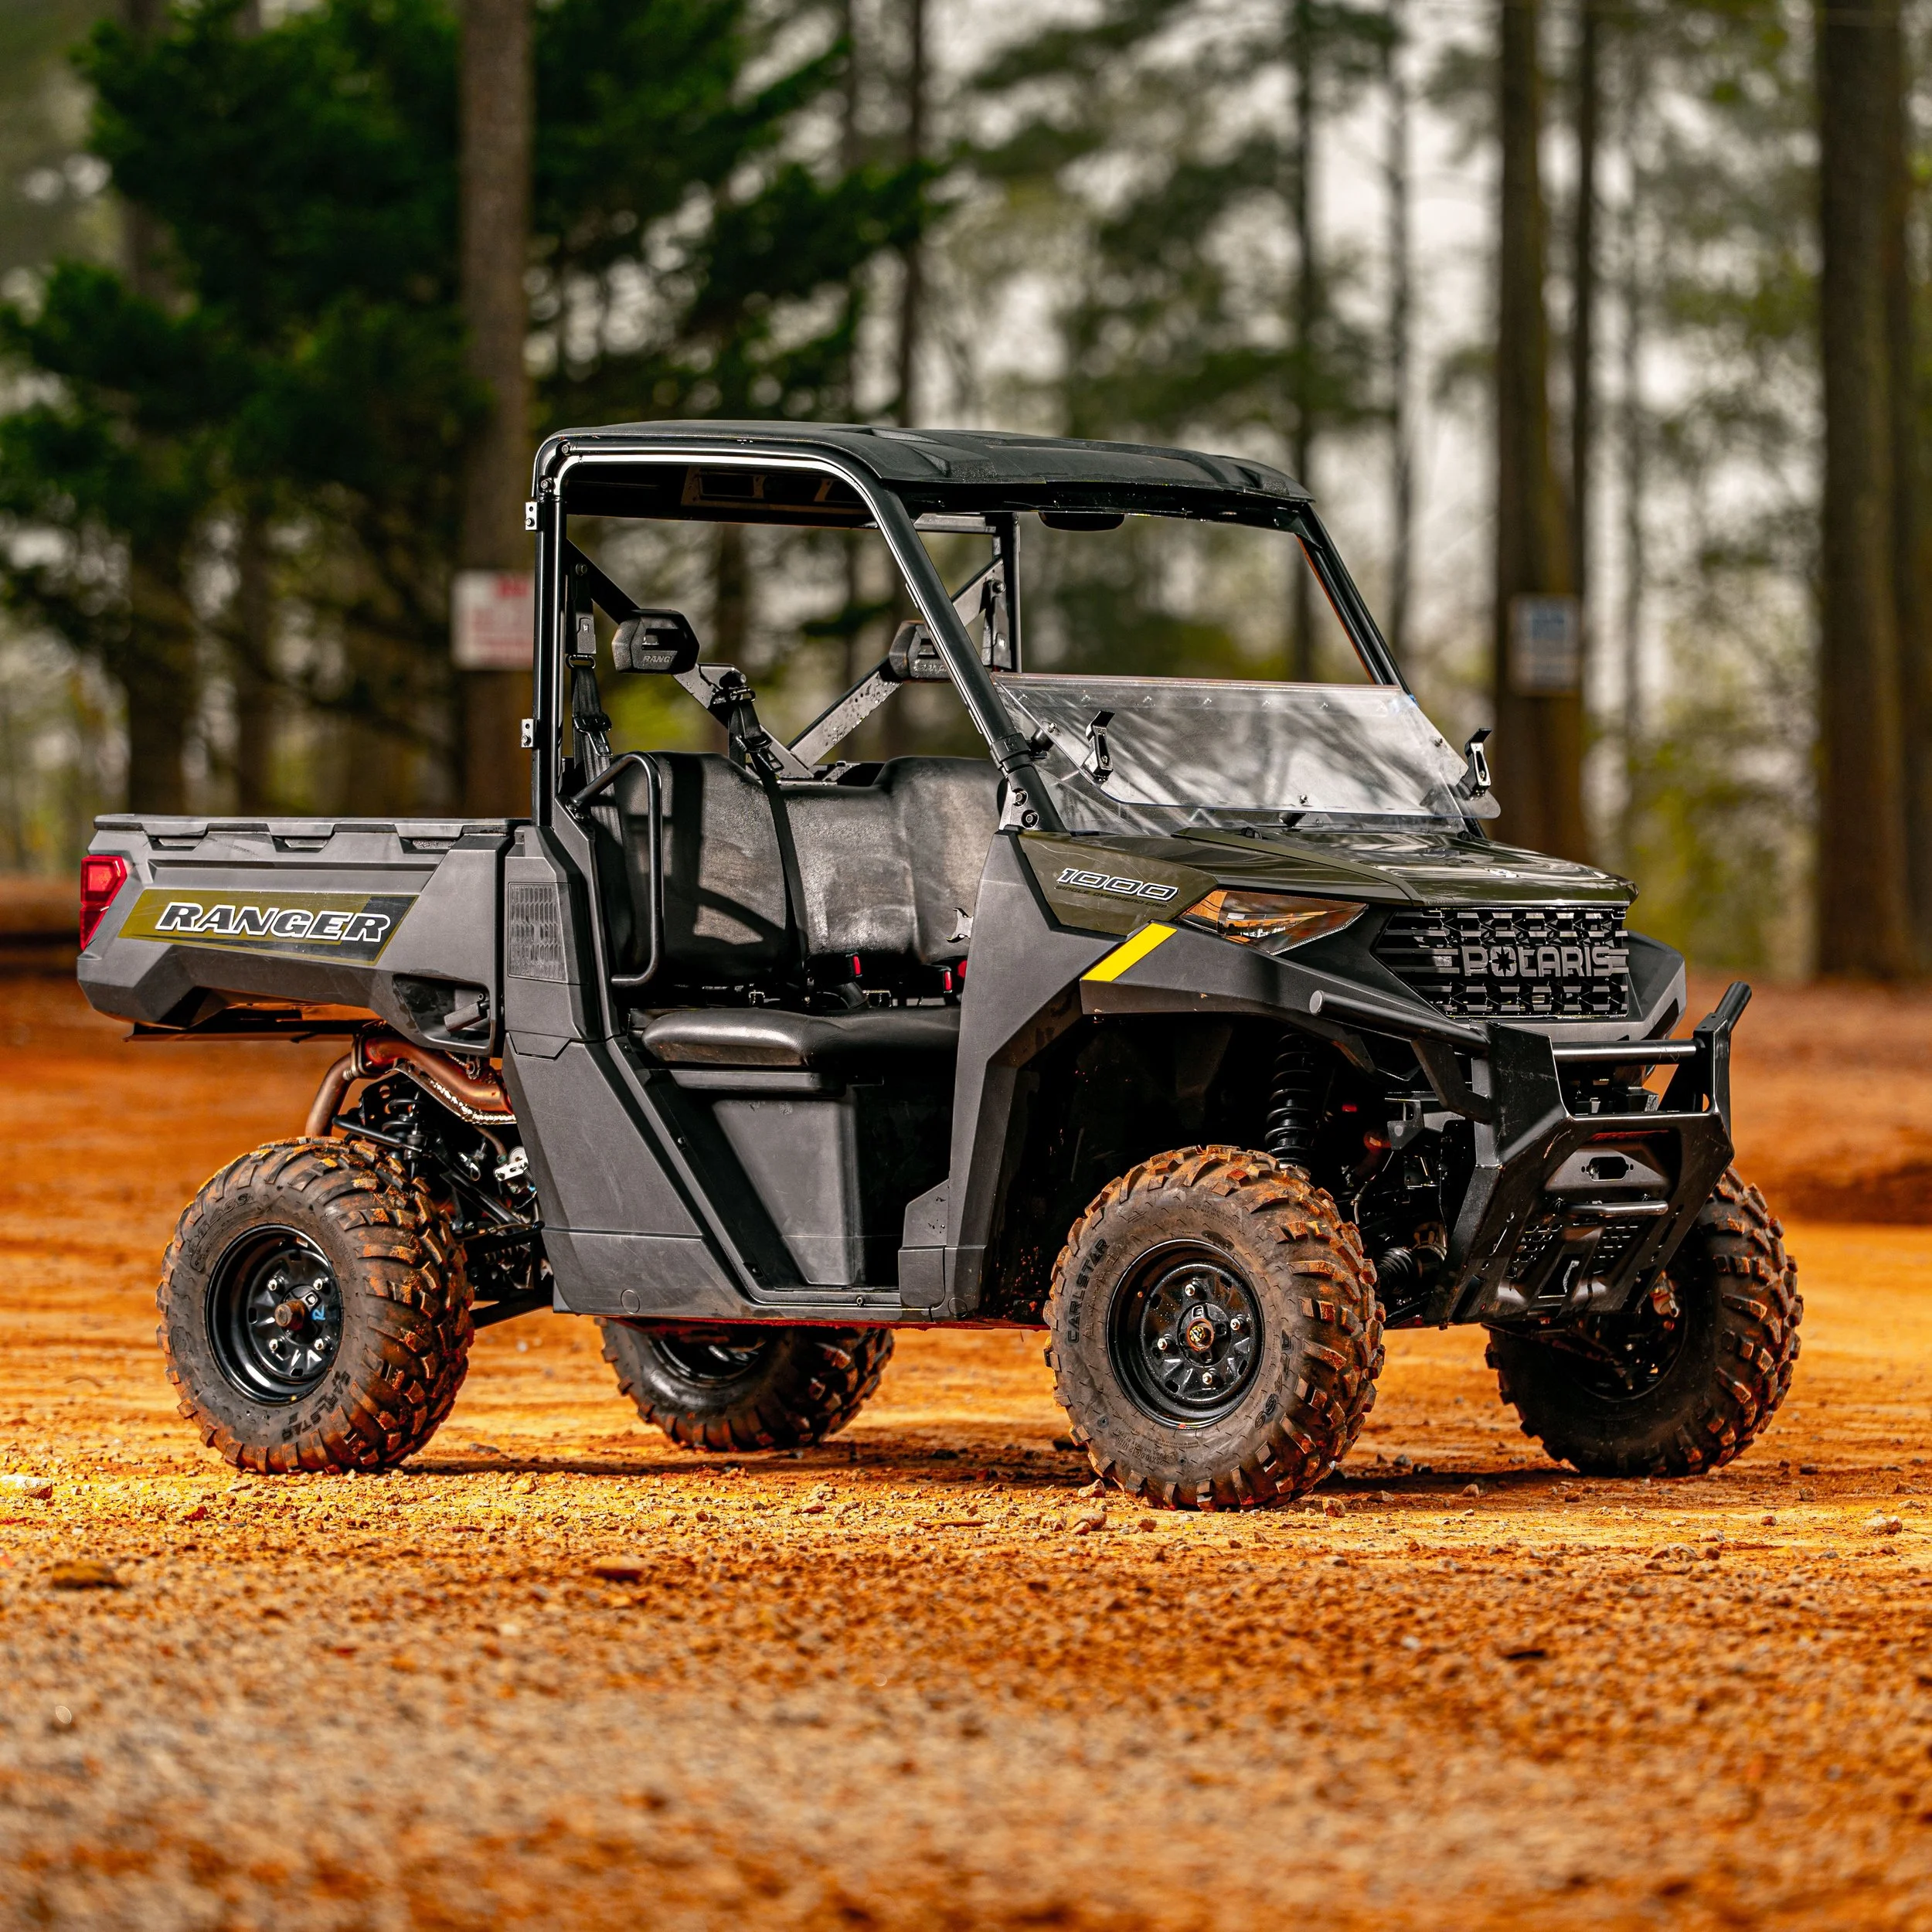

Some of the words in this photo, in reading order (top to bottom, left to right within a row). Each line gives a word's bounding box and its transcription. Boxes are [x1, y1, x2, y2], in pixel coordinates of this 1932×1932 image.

[1056, 867, 1180, 902] 1000
[1056, 885, 1090, 894] SINGLE
[1094, 892, 1145, 905] OVERHEAD
[155, 901, 390, 942] RANGER
[1461, 945, 1613, 977] POLARIS
[1067, 1238, 1110, 1343] CARLSTAR
[282, 1370, 351, 1441] CARLSTAR
[1116, 1437, 1130, 1451] NHS
